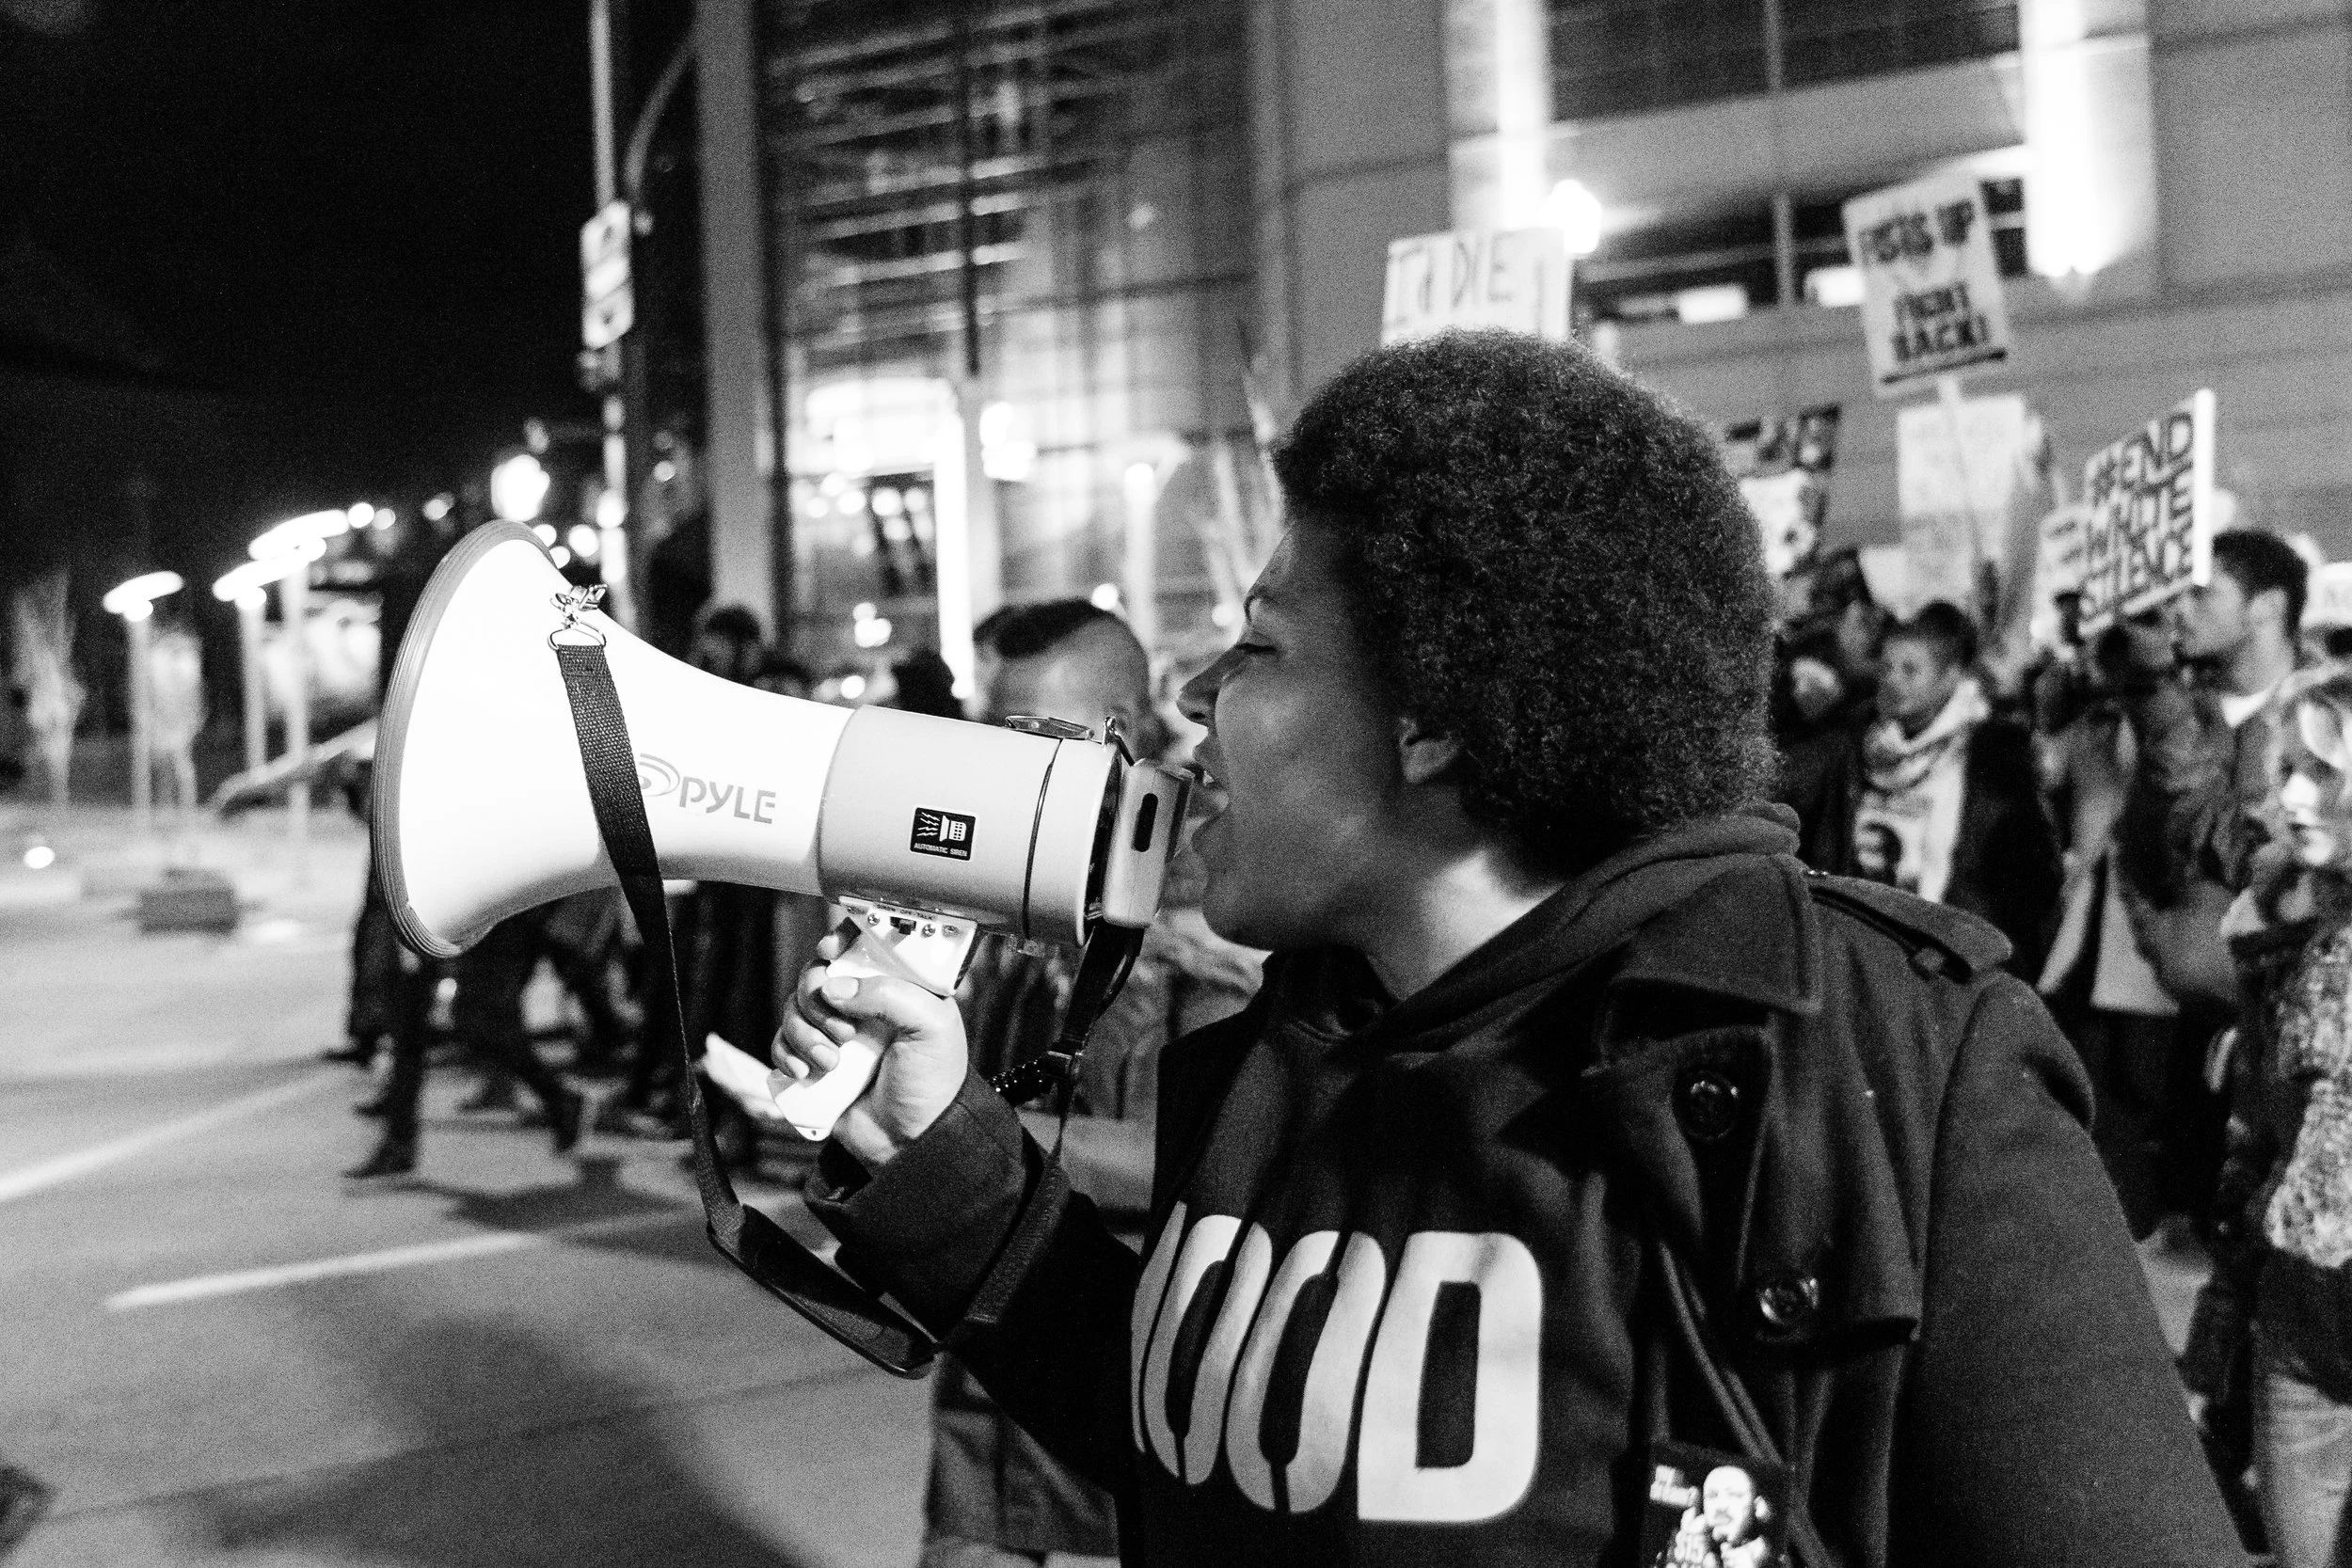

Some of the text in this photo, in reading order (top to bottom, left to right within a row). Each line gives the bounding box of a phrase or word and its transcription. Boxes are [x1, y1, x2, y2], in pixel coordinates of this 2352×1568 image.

[679, 776, 776, 824] PYLE
[914, 842, 968, 857] AUTOMATIC SIREN
